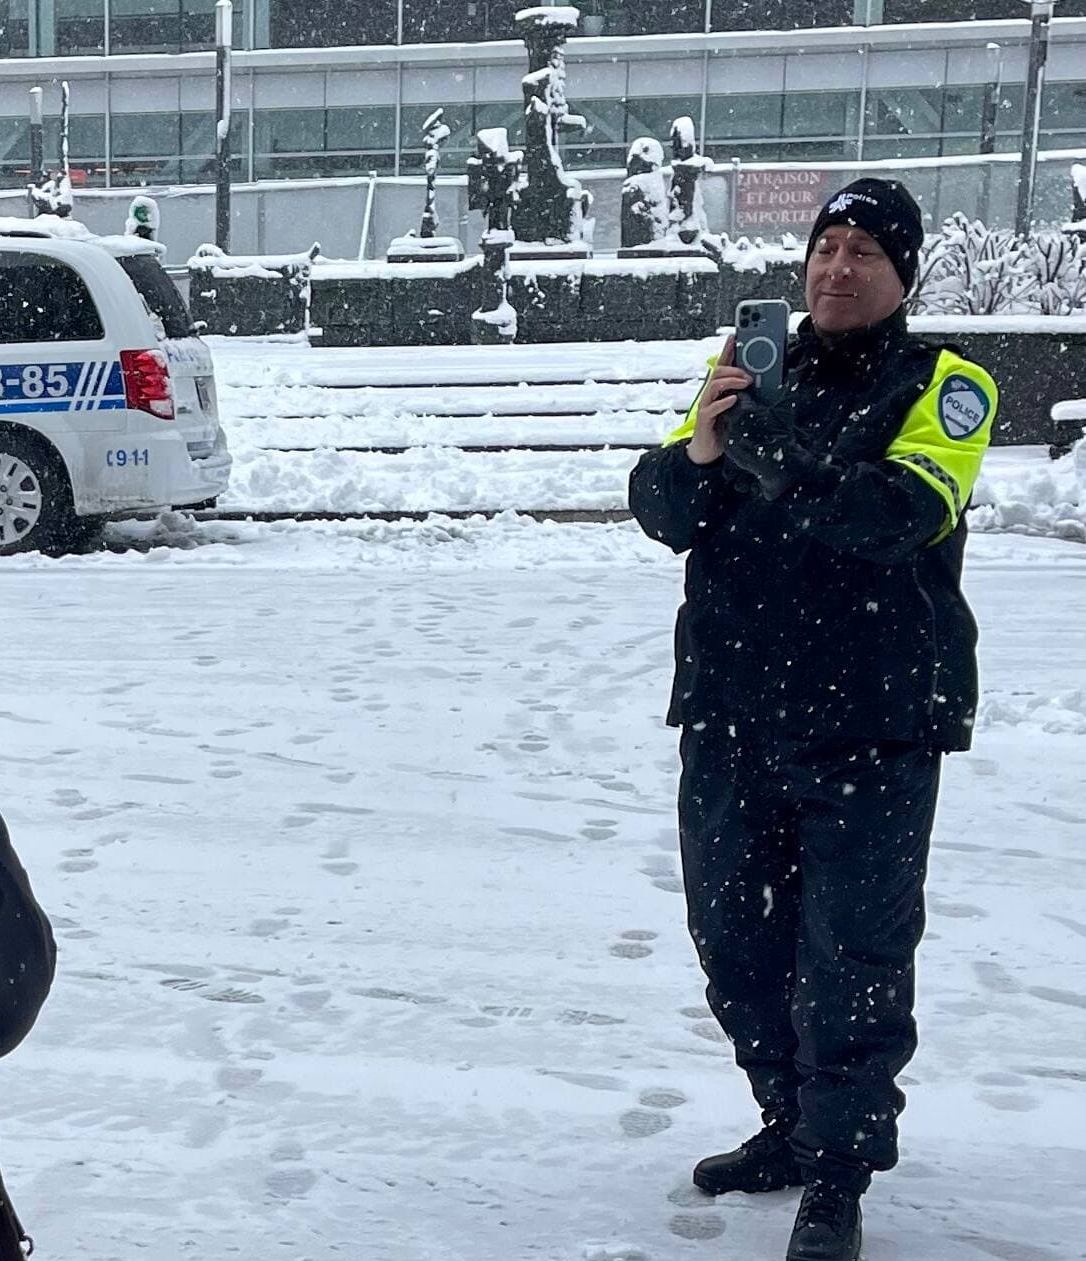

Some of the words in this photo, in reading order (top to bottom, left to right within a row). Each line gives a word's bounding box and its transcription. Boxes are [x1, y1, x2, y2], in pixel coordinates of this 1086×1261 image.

[747, 191, 765, 204] ET
[769, 191, 812, 204] POUR
[945, 396, 980, 424] POLICE
